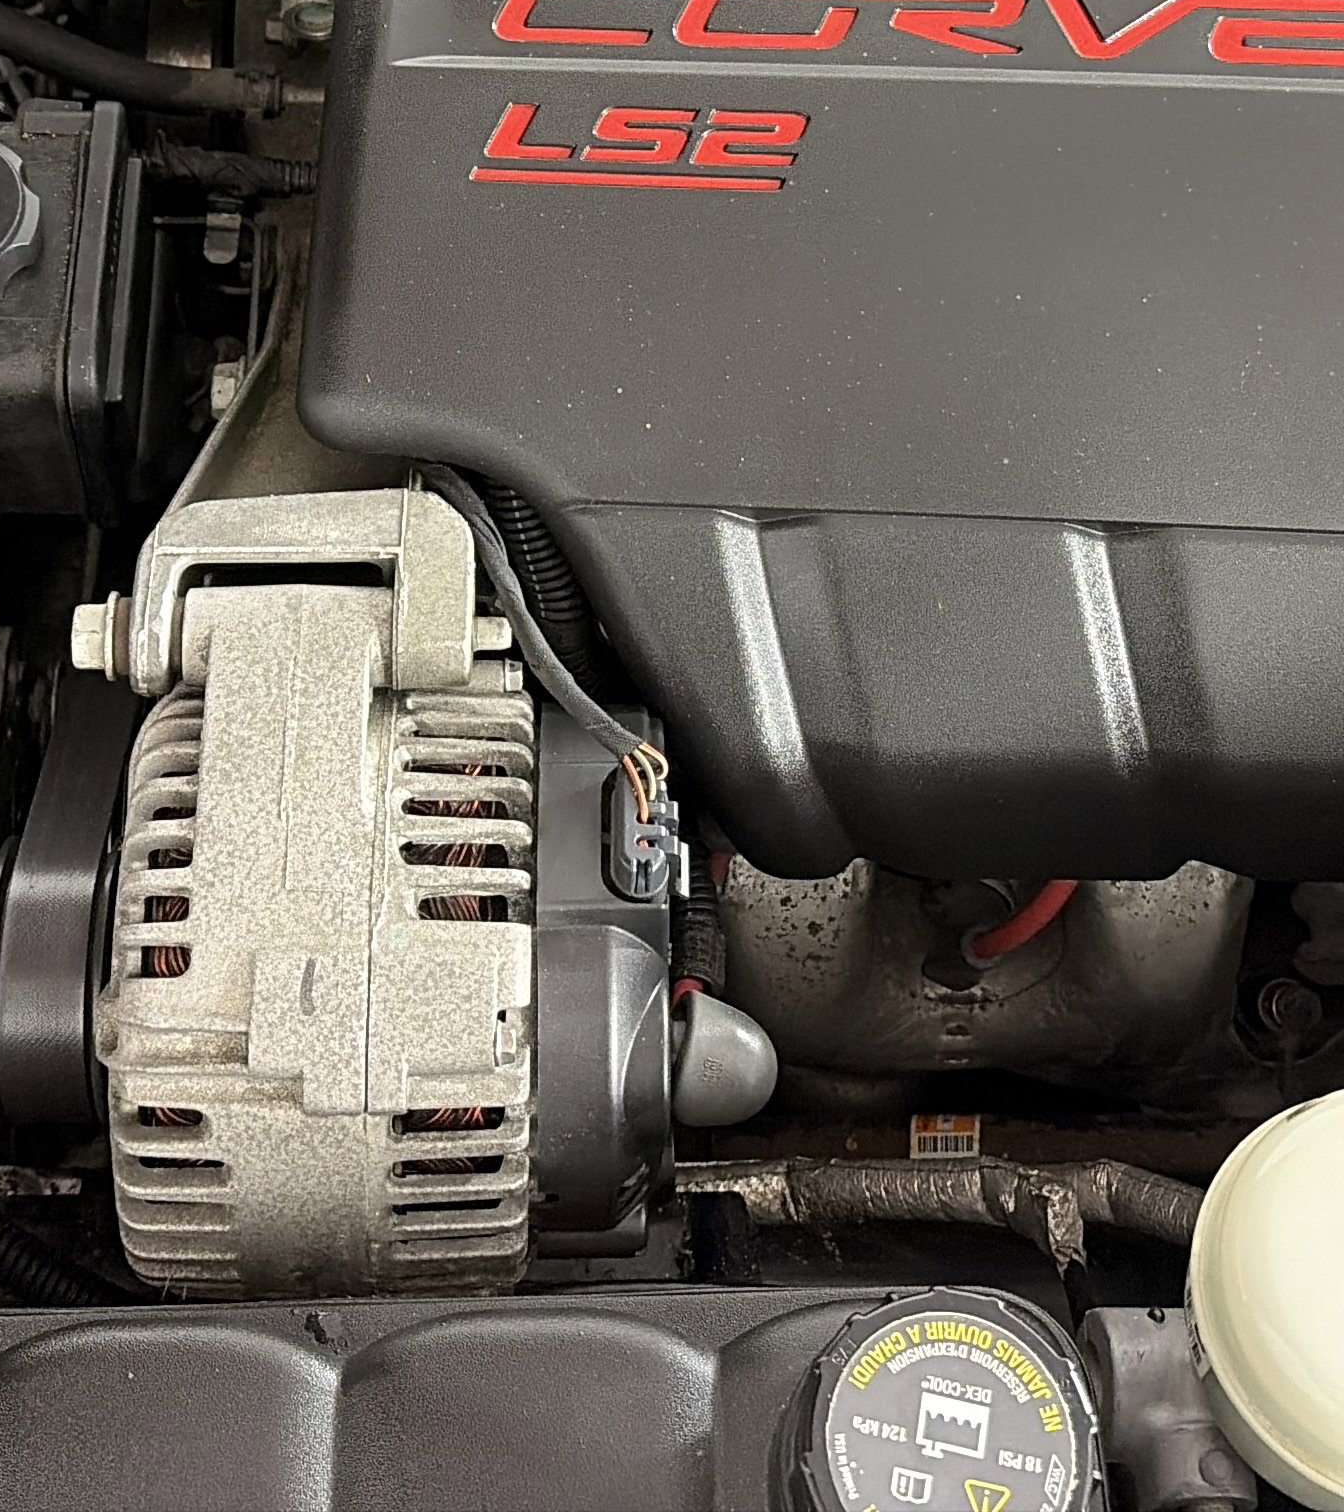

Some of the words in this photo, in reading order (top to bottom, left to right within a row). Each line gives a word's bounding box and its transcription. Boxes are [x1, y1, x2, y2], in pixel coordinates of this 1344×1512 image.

[483, 102, 810, 167] LS2
[924, 1321, 992, 1347] OUVRIR
[848, 1333, 906, 1390] CHAUD!
[886, 1341, 968, 1375] D'EXPANSION
[992, 1338, 1053, 1400] JAMAIS
[970, 1345, 1031, 1404] RÉSERVOIR
[852, 1415, 881, 1435] kPa
[1039, 1403, 1063, 1432] NE
[881, 1424, 907, 1442] 124
[998, 1449, 1024, 1470] PSI
[1025, 1455, 1043, 1474] 18
